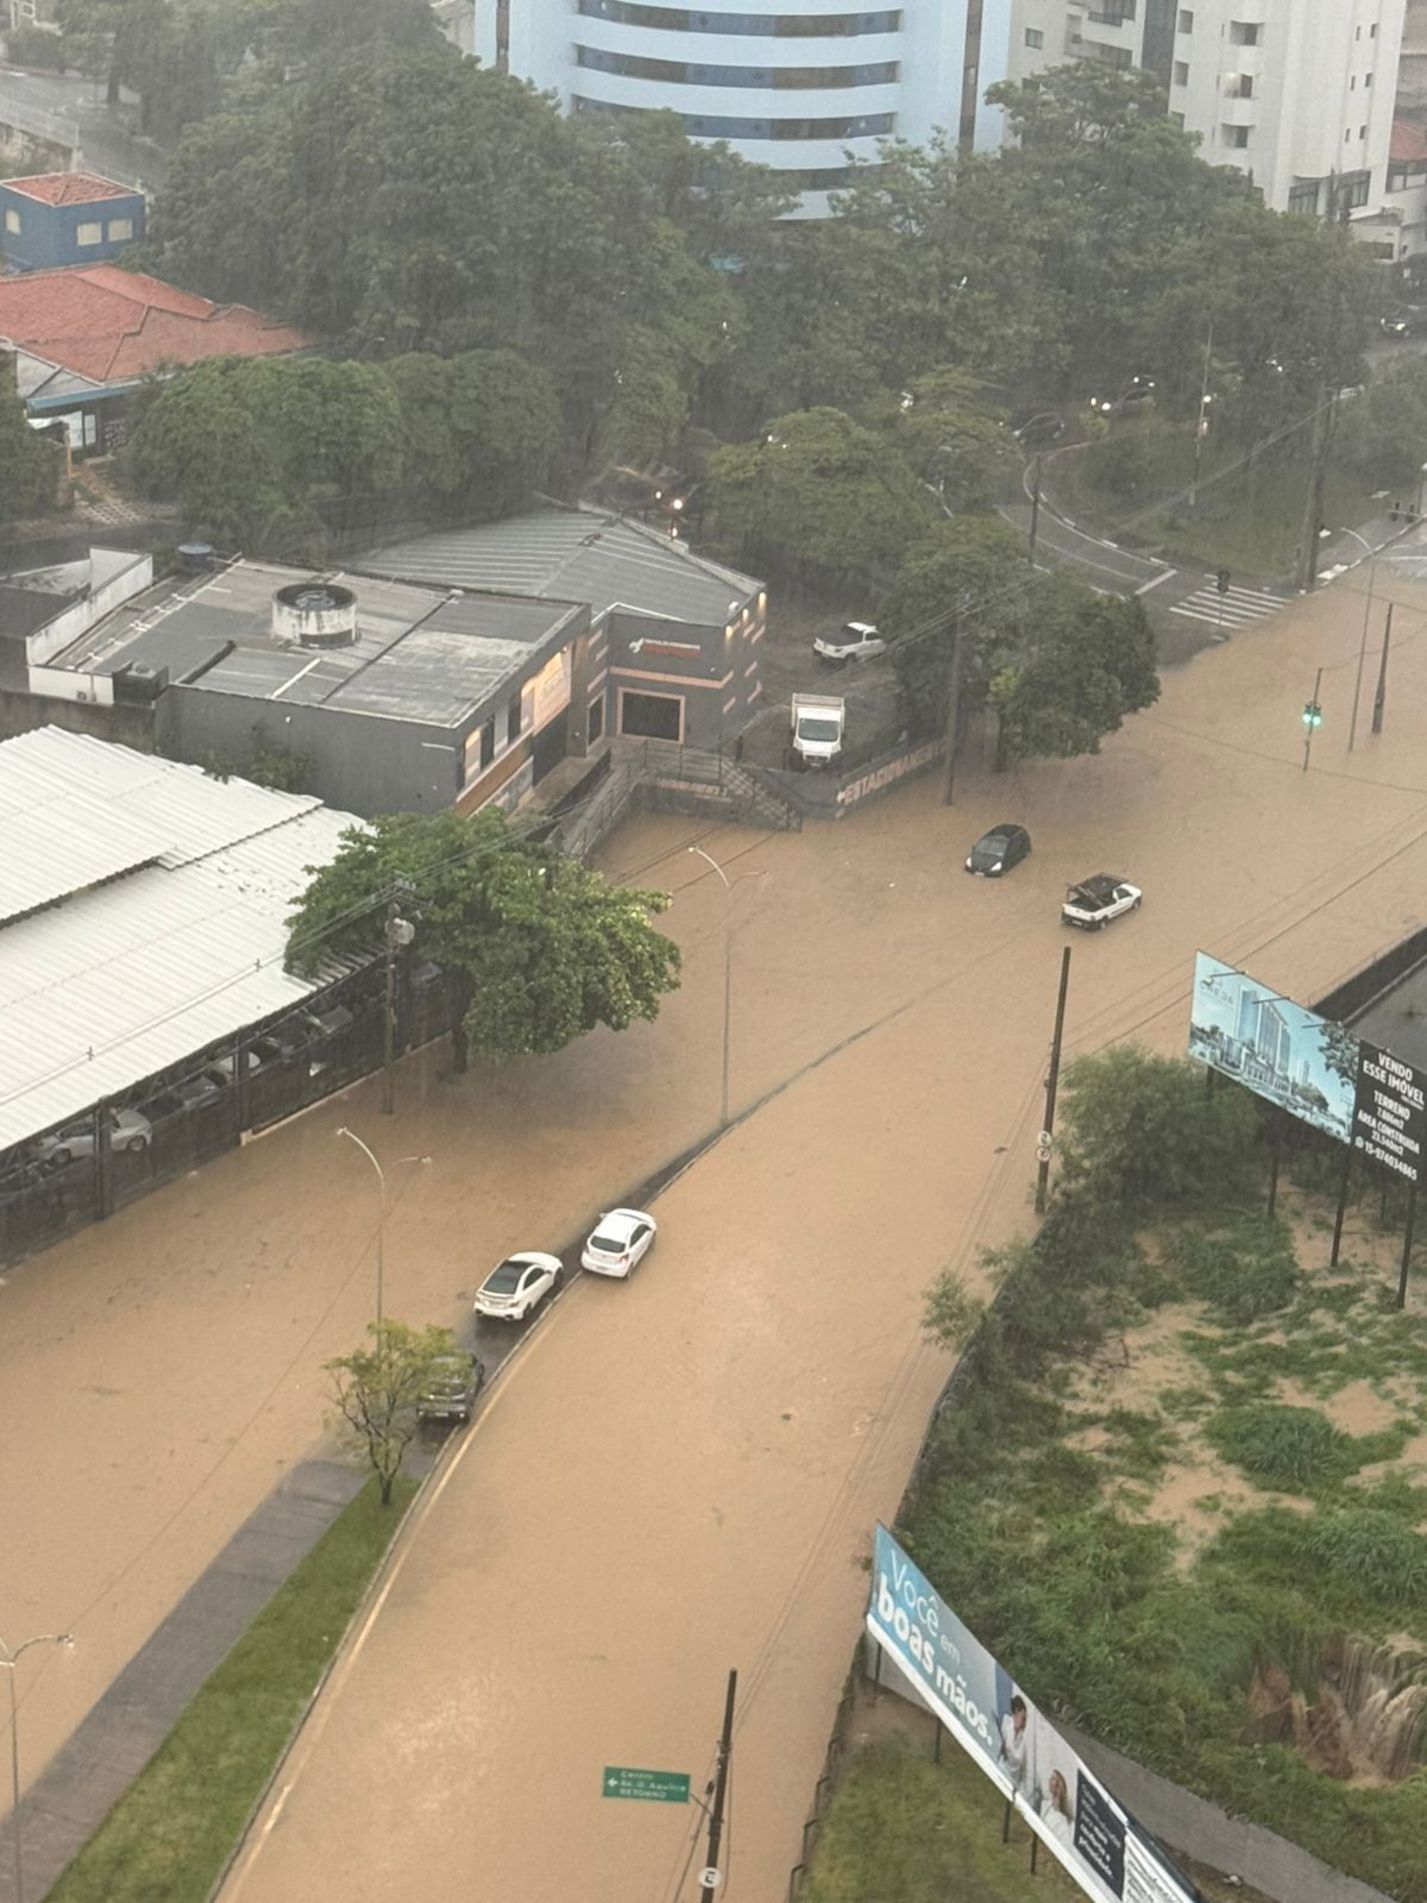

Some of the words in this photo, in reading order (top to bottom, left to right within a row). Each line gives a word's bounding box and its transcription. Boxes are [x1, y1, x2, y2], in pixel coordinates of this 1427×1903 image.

[1363, 1059, 1387, 1084] ESSE
[1378, 1052, 1413, 1082] VENDO
[1374, 1089, 1411, 1120] TERRENO
[890, 1548, 939, 1637] Você
[940, 1634, 961, 1665] em
[877, 1571, 935, 1675] boas
[935, 1674, 994, 1747] mãos.
